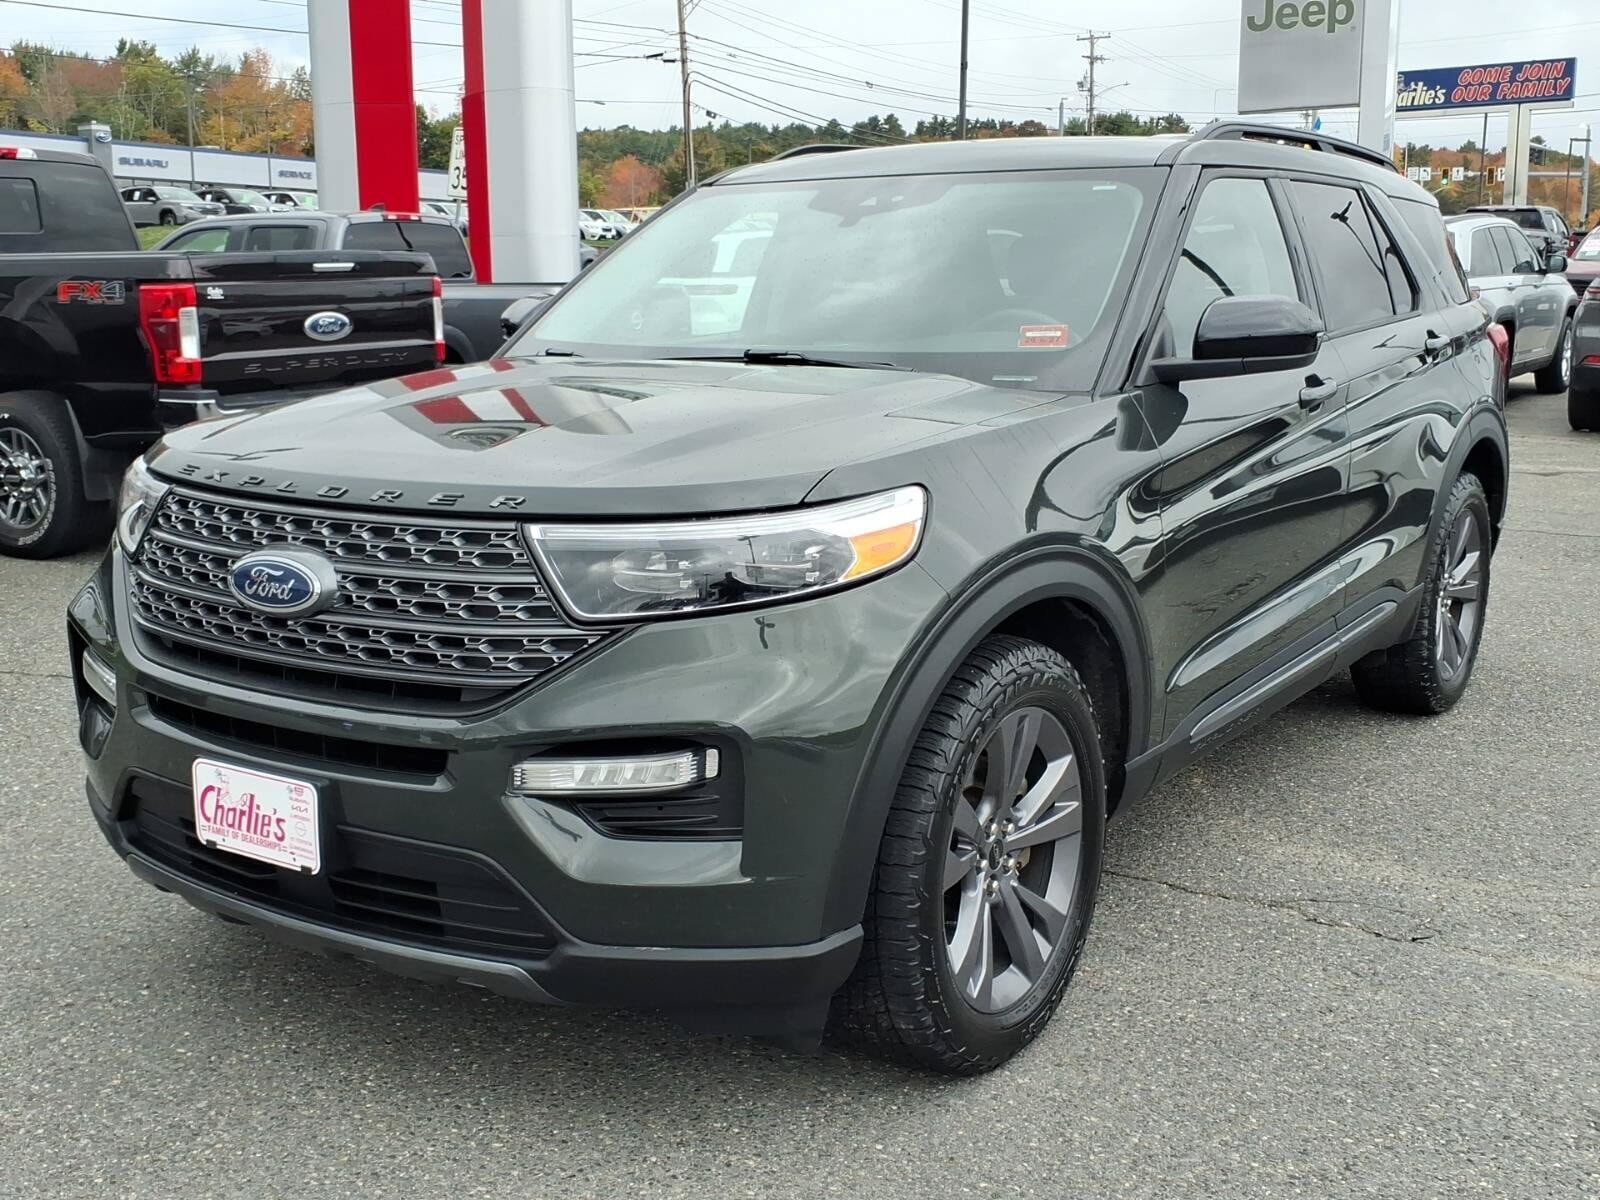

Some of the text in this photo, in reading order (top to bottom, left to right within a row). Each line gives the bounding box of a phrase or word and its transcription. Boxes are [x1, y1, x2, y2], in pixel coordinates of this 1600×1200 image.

[1247, 0, 1355, 33] Jeep
[1457, 61, 1566, 86] COME JOIN
[1397, 82, 1446, 107] arlie's
[1451, 77, 1571, 103] OUR FAMILY
[118, 156, 169, 169] SUBARU
[278, 169, 313, 180] SERVICE
[56, 280, 126, 303] FX4
[316, 317, 343, 333] Ford
[244, 351, 409, 374] SUPER DUTY
[177, 463, 528, 510] EXPLORER
[245, 565, 296, 600] Ford
[200, 785, 286, 842] Charlie's
[207, 825, 230, 837] FAMILY
[231, 831, 240, 839] OF
[241, 833, 282, 851] DEALERSHIPS
